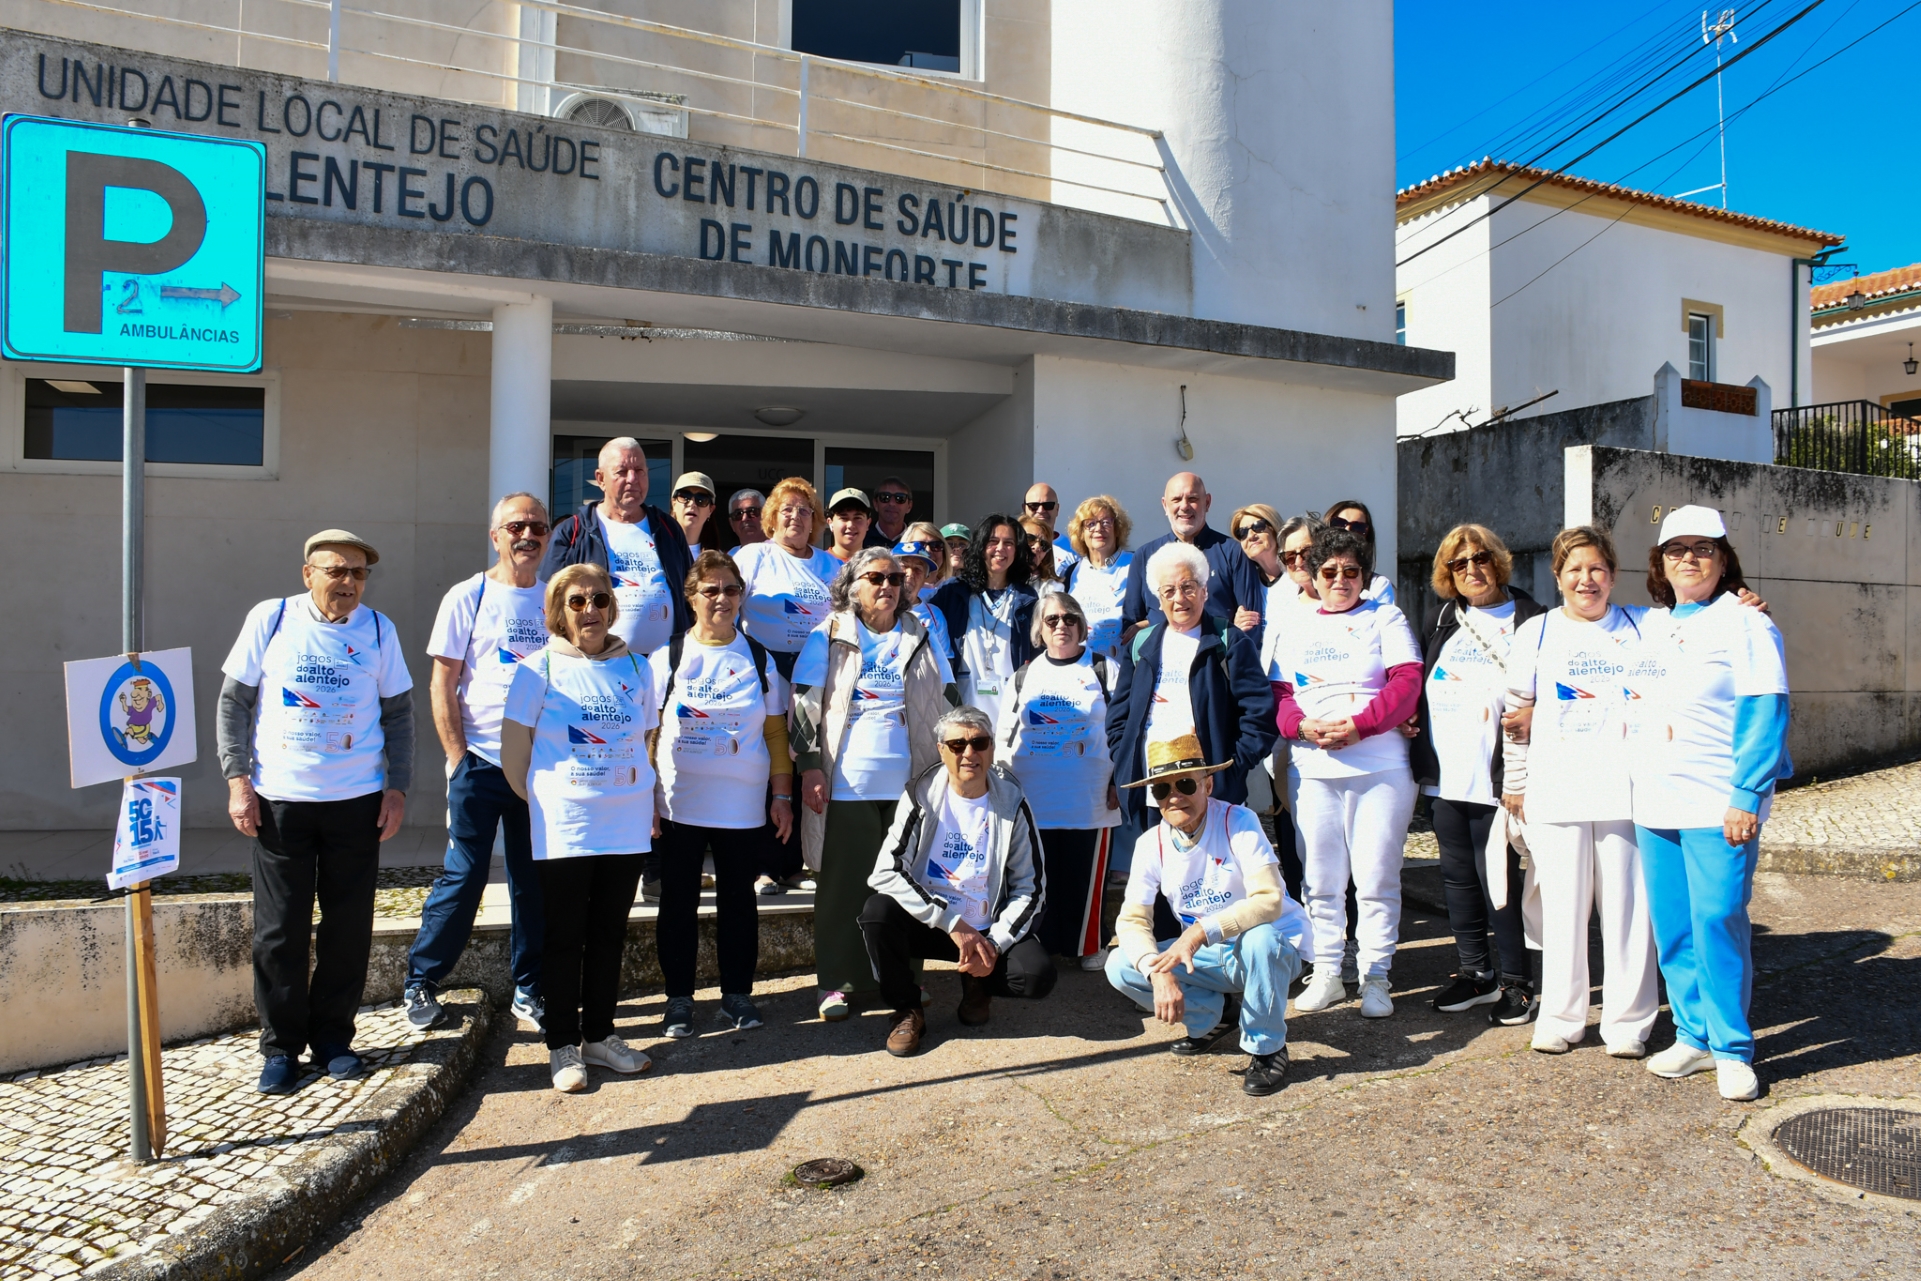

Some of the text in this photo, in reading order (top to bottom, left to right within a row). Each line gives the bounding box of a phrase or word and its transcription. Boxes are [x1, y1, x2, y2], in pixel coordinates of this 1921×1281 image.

[38, 53, 600, 180] UNIDADE LOCAL DE SAÚDE
[266, 151, 494, 226] ENTEJO
[654, 152, 1018, 253] CENTRO DE SAÚDE
[64, 150, 208, 335] P
[700, 218, 987, 290] DE MONFORTE
[120, 323, 240, 344] AMBULÂNCIAS
[795, 593, 832, 602] alentejo
[505, 617, 533, 627] jogos
[297, 652, 332, 664] jogos
[1304, 652, 1349, 664] alentejo
[309, 665, 335, 676] alto
[1569, 663, 1624, 676] alentejo
[295, 674, 350, 688] alentejo
[580, 694, 611, 704] jogos
[687, 692, 733, 701] alentejo
[1040, 698, 1081, 707] alentejo
[594, 704, 617, 713] alto
[582, 712, 632, 724] alentejo
[325, 731, 354, 753] 50
[714, 736, 740, 756] 50
[613, 765, 638, 786] 50
[130, 819, 154, 846] 15
[945, 830, 968, 842] jogo
[942, 850, 984, 862] alentejo
[1179, 877, 1207, 895] jogo
[1195, 888, 1214, 898] alto
[1186, 891, 1232, 909] alentejo
[964, 898, 989, 918] 50
[1205, 904, 1223, 913] 2026
